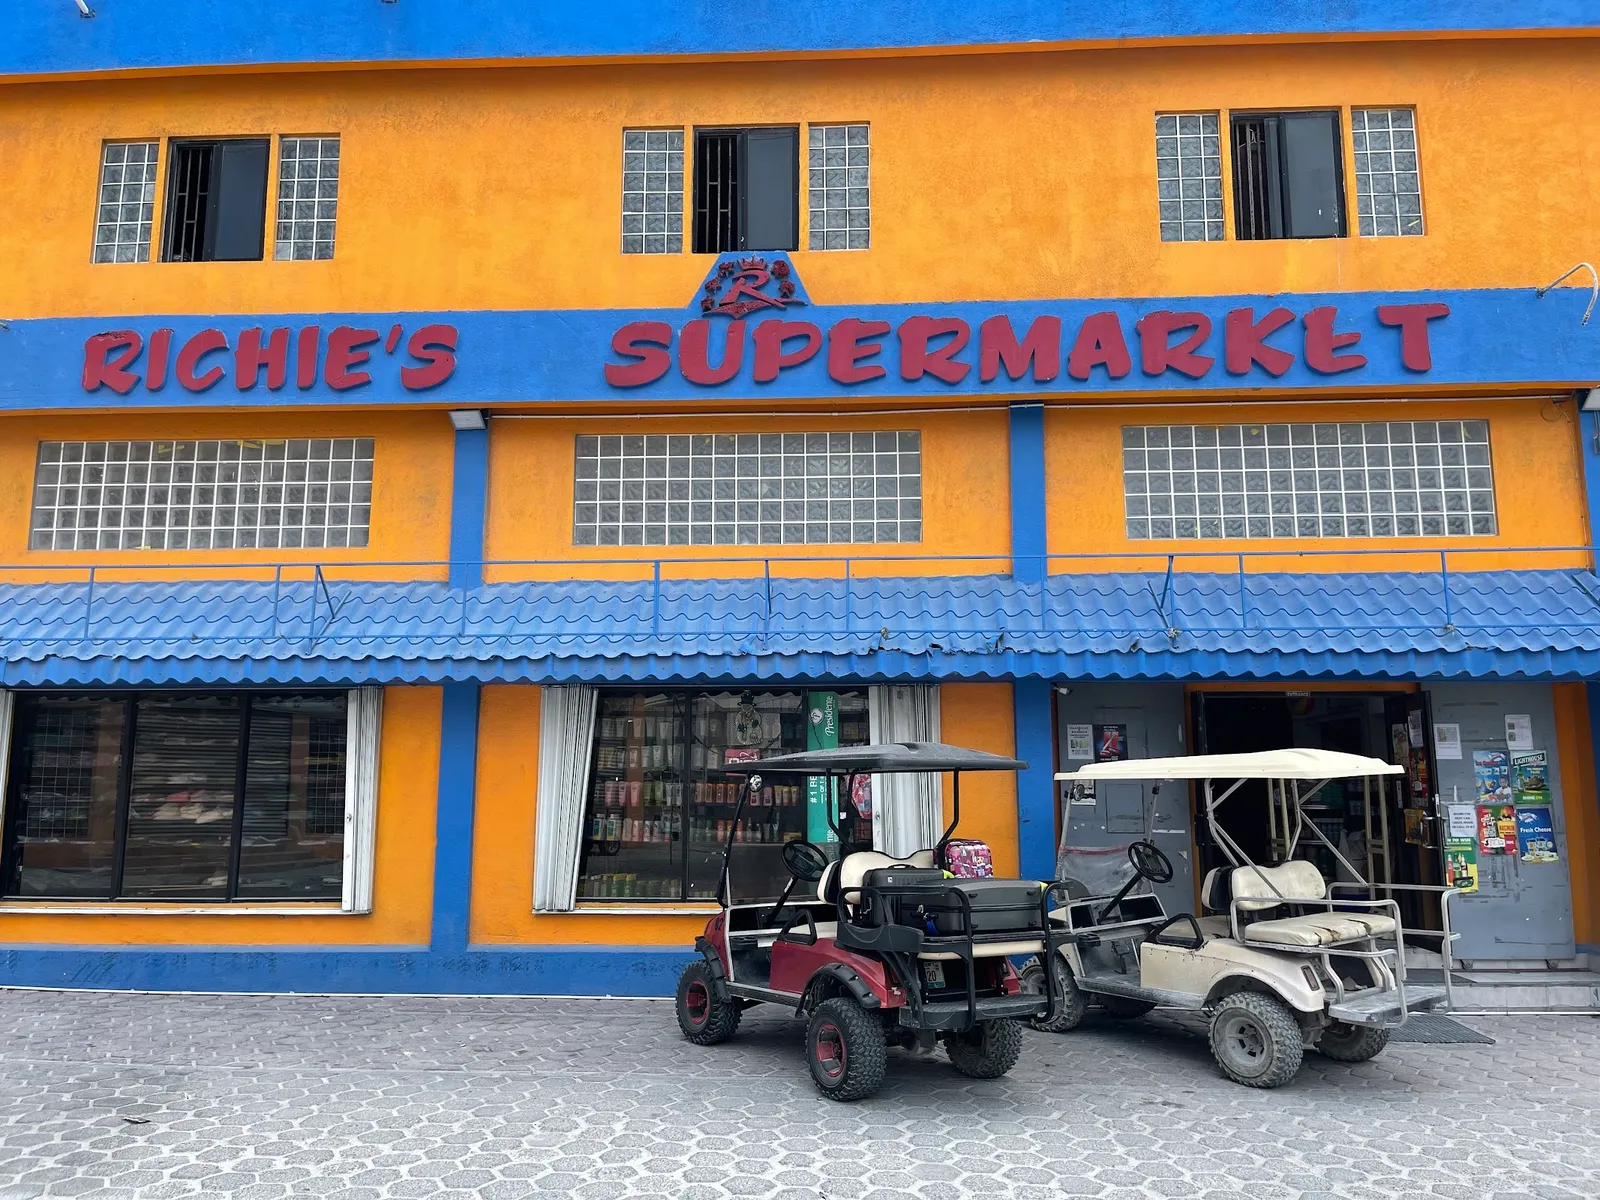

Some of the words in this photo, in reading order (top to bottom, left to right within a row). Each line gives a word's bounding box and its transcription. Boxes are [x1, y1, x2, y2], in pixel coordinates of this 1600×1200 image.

[83, 325, 459, 393] RICHIE'S
[604, 303, 1450, 388] SUPERMARKET
[824, 695, 835, 737] Presidente
[1514, 753, 1543, 765] LIGHTHOUSE
[809, 775, 817, 787] BE
[927, 970, 937, 981] 20
